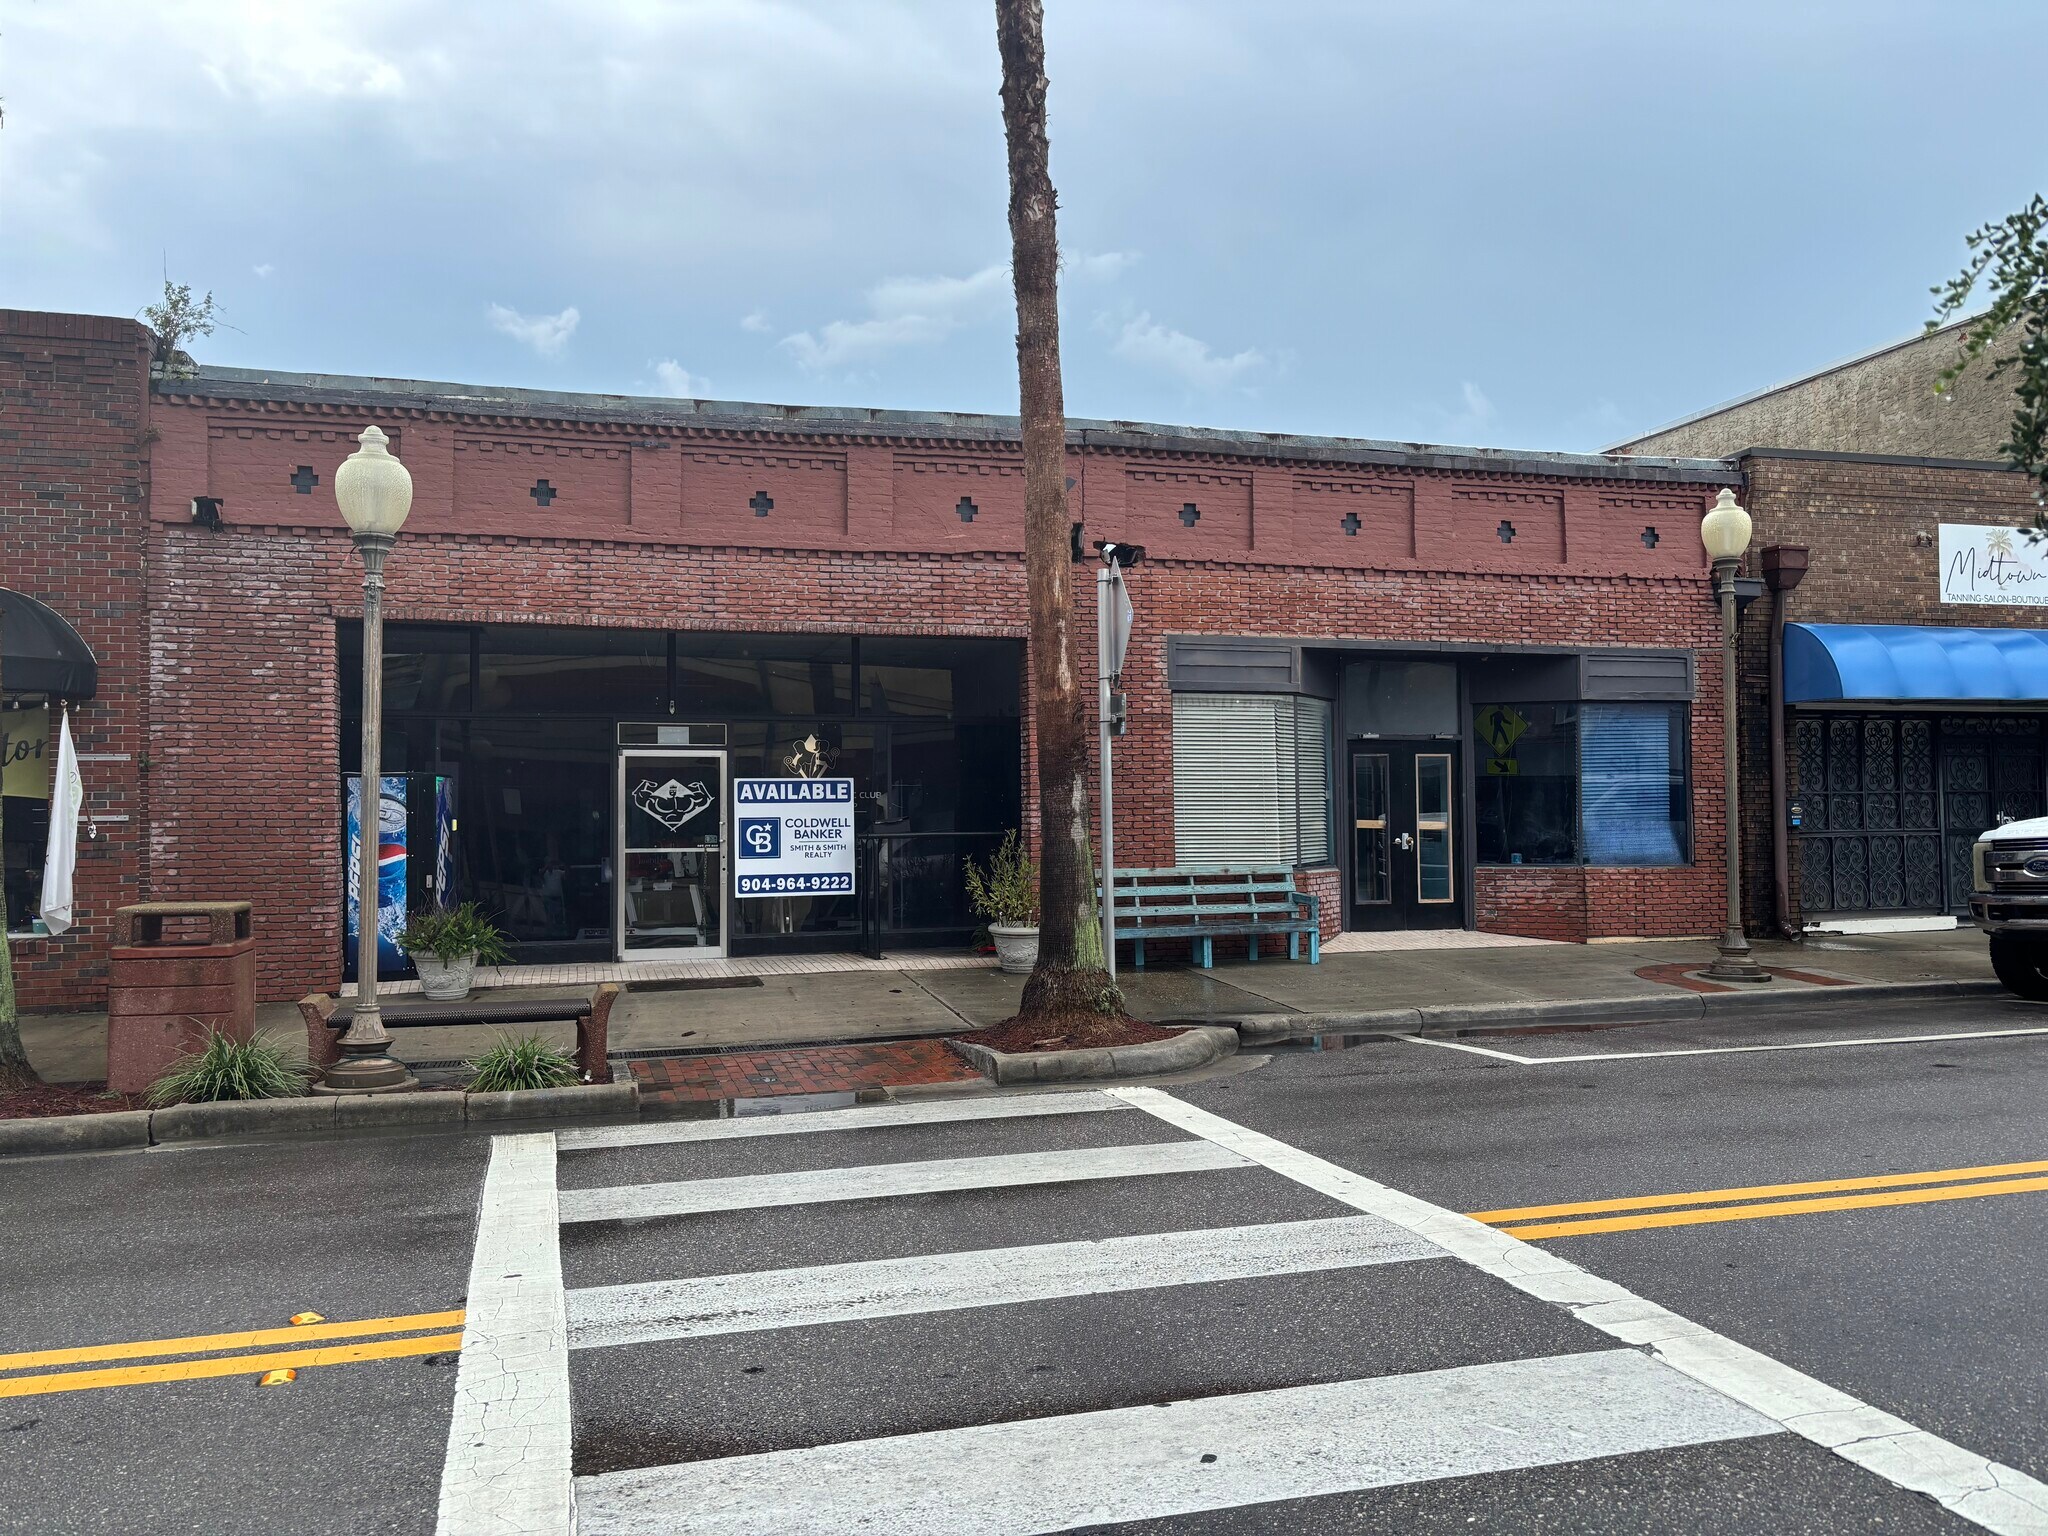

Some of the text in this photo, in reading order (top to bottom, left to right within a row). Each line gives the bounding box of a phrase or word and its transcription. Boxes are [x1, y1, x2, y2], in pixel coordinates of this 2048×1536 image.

[1945, 547, 2047, 593] Midtown
[740, 783, 849, 800] AVAILABLE
[859, 791, 882, 799] CLUB
[785, 817, 851, 829] COLDWELL
[794, 829, 842, 839] BANKER
[790, 844, 815, 852] SMITH
[822, 843, 847, 851] SMITH
[435, 814, 451, 908] PEPSI
[741, 876, 850, 891] 904-964-9222
